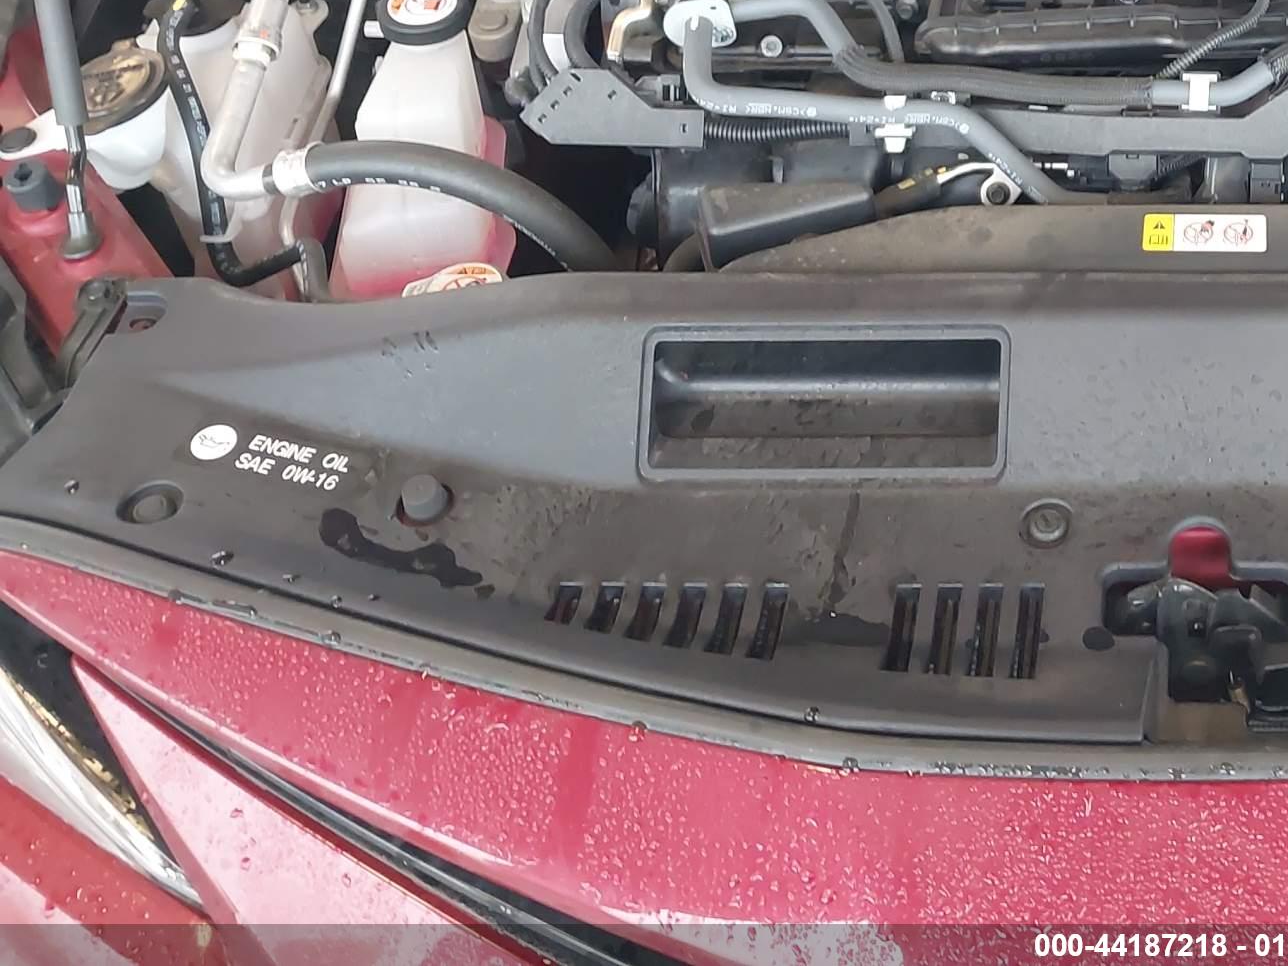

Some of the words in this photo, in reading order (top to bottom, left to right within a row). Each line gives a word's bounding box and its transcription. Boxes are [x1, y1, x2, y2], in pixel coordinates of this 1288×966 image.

[235, 453, 275, 475] SAE
[281, 465, 339, 490] 0W-16
[248, 434, 317, 463] ENGINE
[322, 453, 349, 473] OIL
